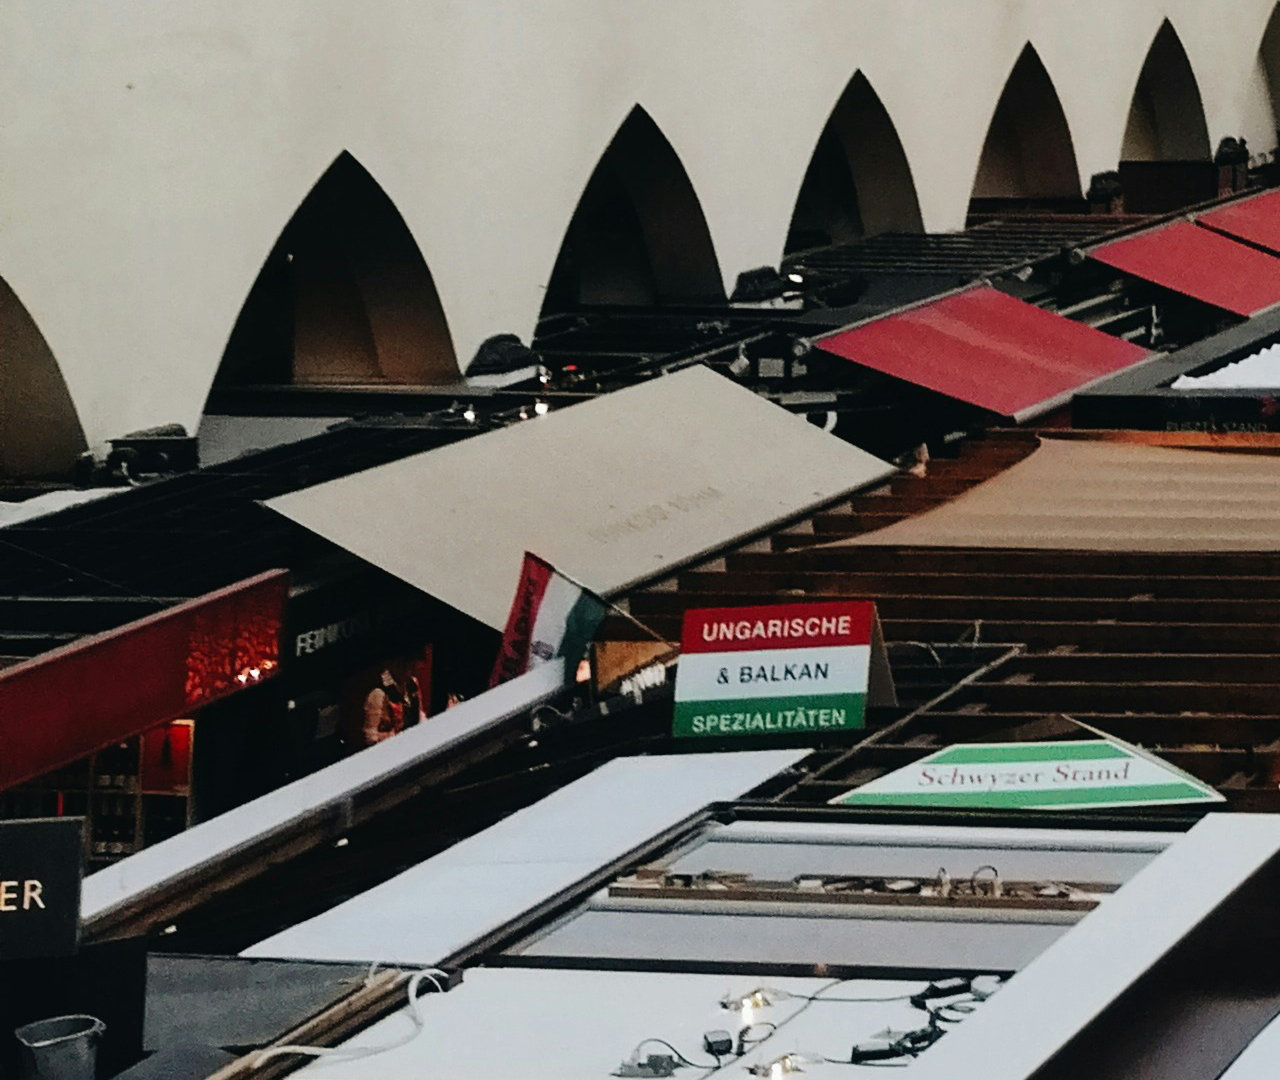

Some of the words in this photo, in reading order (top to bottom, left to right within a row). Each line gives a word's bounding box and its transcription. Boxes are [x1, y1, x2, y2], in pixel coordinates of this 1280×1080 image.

[702, 615, 851, 642] UNGARISCHE
[716, 667, 729, 685] &
[739, 663, 829, 684] BALKAN
[691, 707, 847, 733] SPEZIALITÄTEN
[917, 766, 1045, 792] Schwyzer
[1052, 762, 1130, 784] Stand
